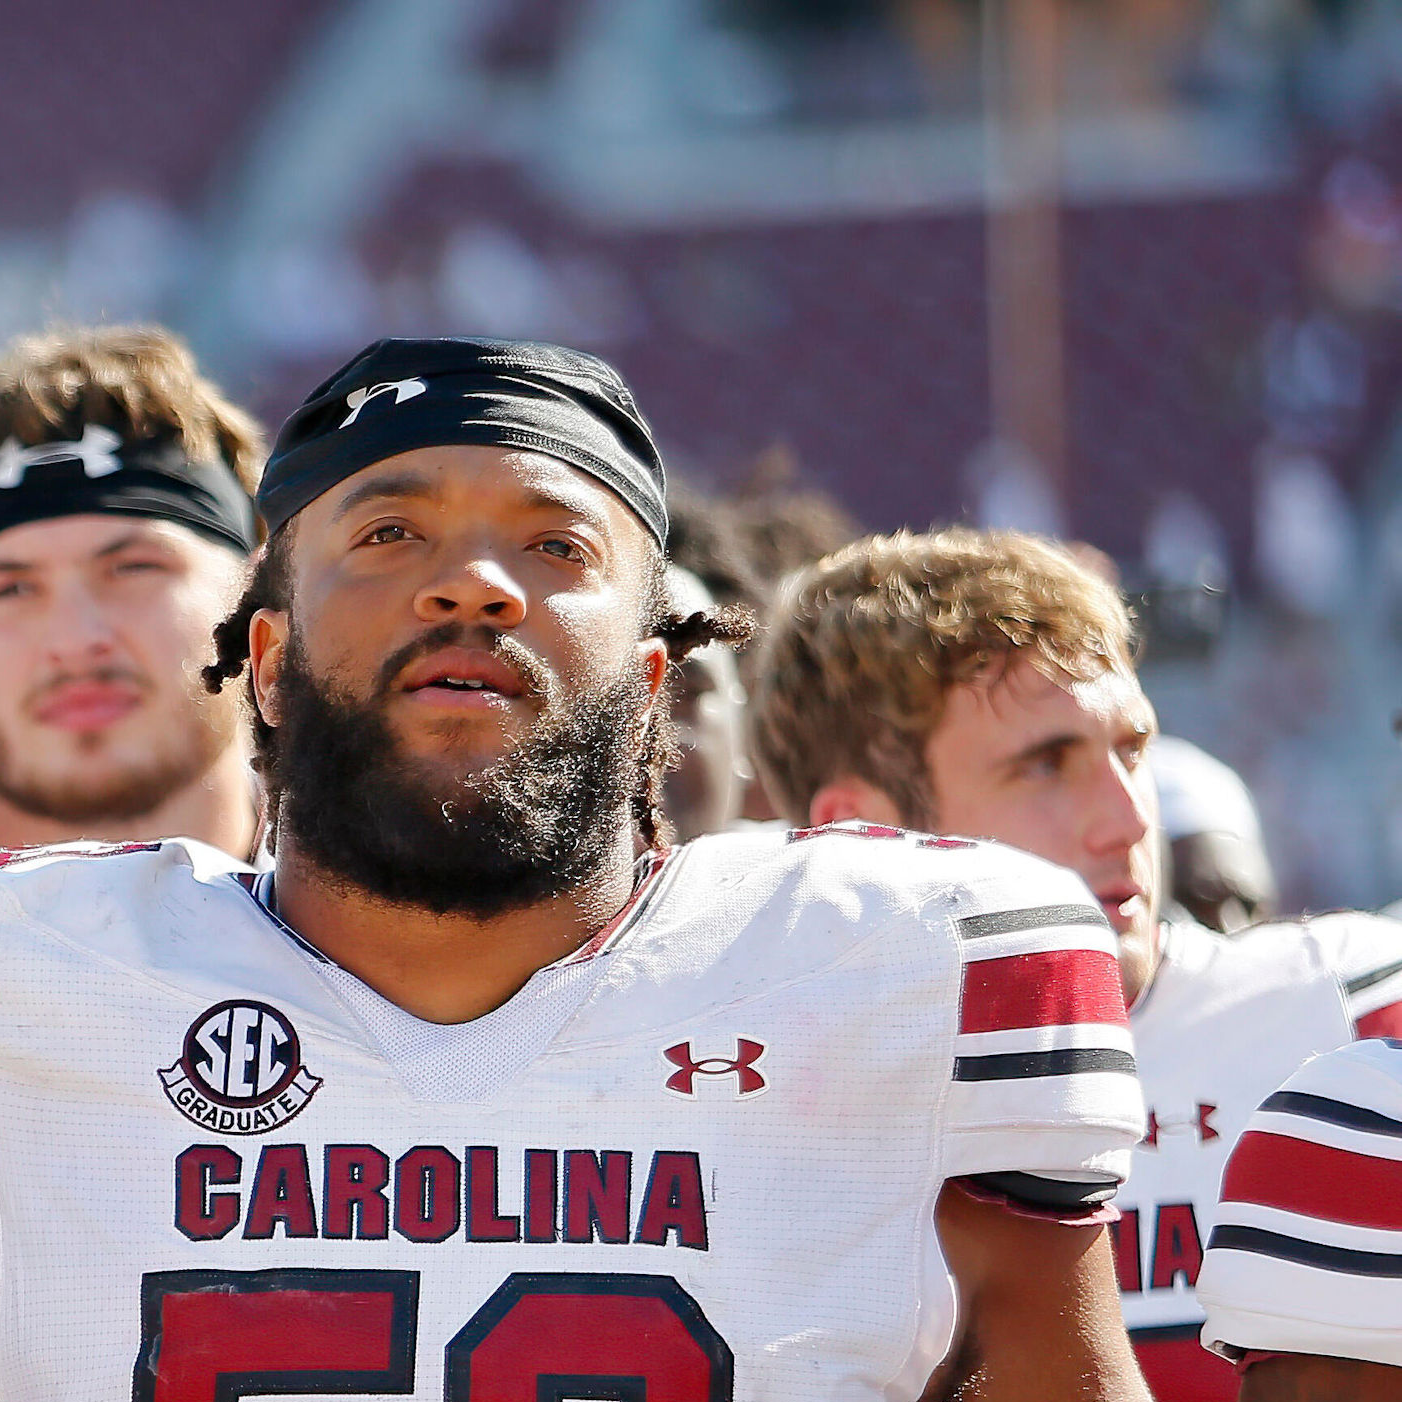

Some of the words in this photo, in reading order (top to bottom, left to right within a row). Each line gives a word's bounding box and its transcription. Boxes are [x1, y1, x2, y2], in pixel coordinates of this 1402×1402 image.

[194, 1006, 290, 1099] SEC
[175, 1086, 298, 1131] GRADUATE
[174, 1142, 709, 1252] CAROLINA
